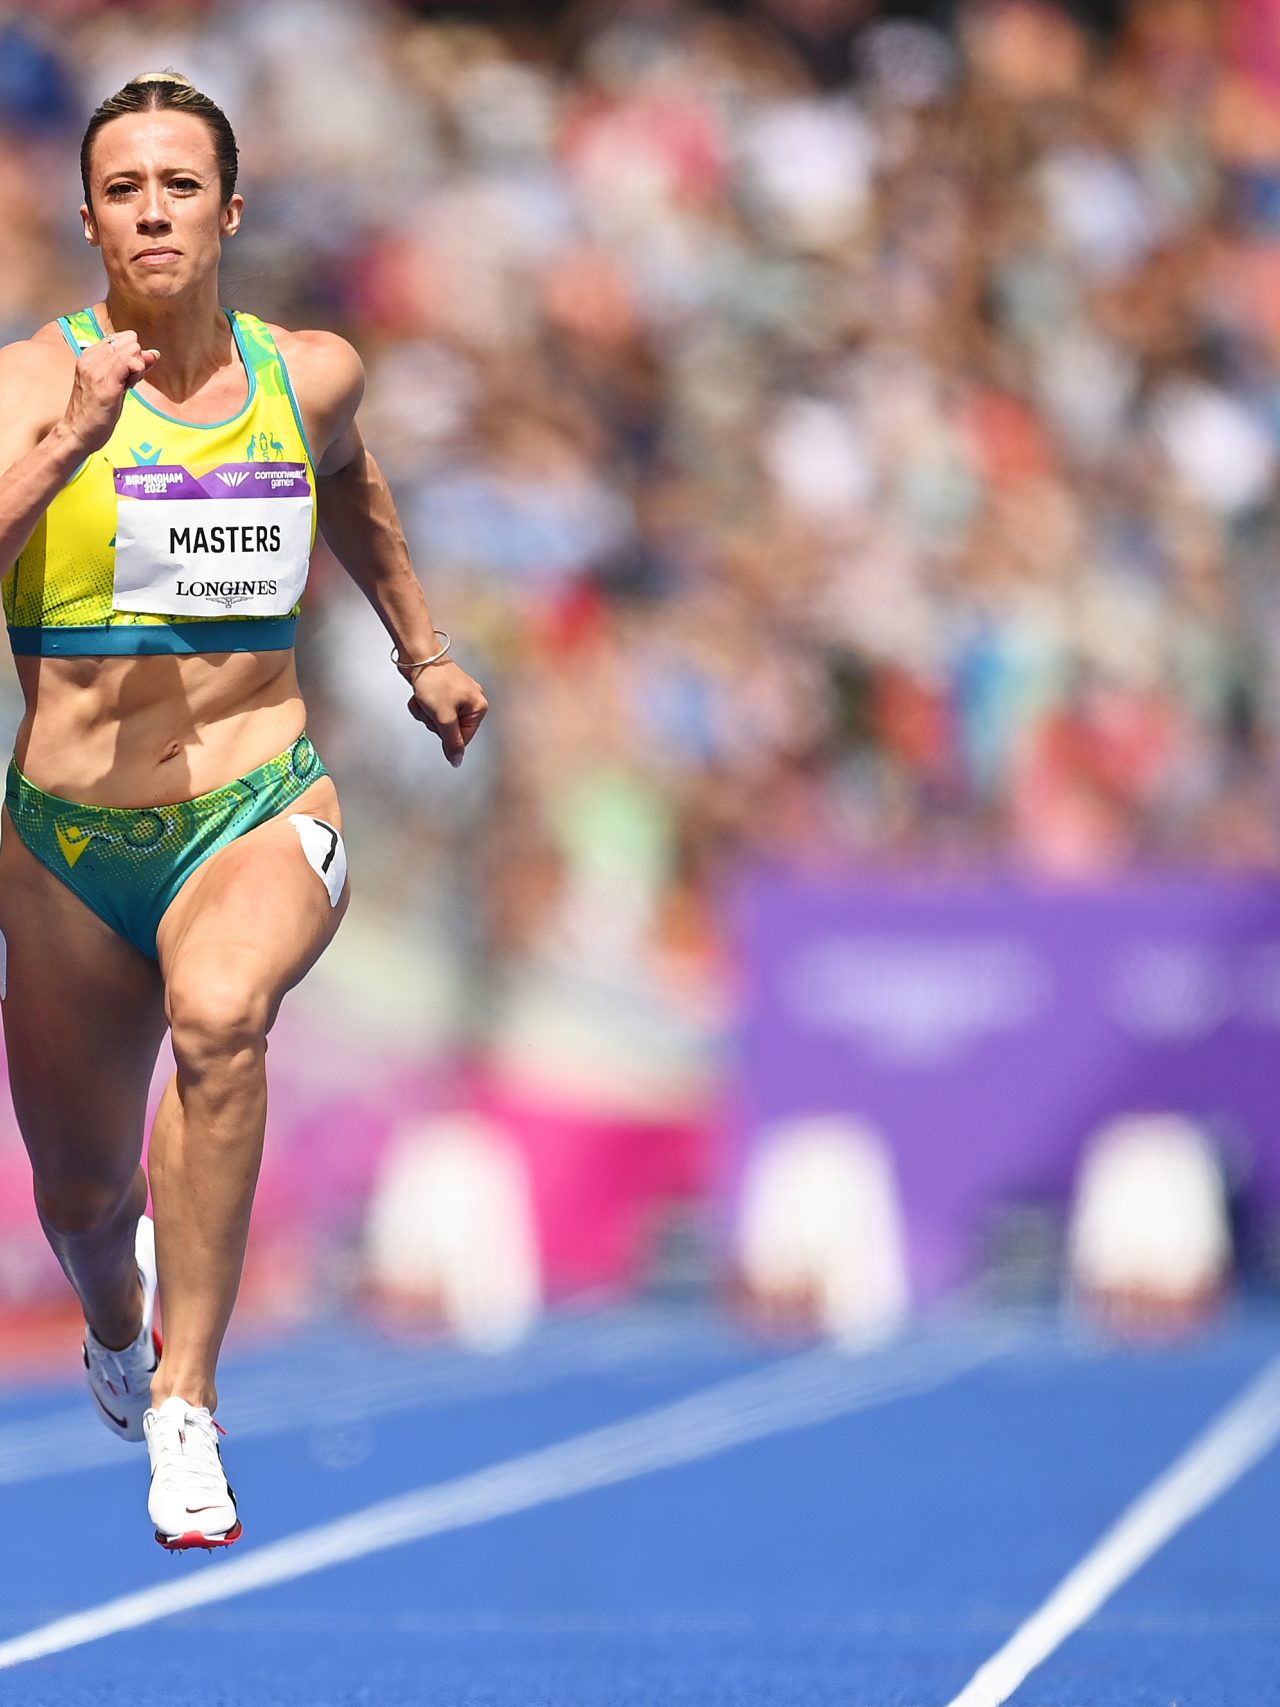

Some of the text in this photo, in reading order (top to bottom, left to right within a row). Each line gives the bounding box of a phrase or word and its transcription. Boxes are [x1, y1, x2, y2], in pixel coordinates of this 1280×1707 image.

[125, 472, 183, 485] BIRMINGHAM
[271, 479, 294, 489] games
[144, 483, 167, 494] 2022
[169, 525, 281, 554] MASTERS
[176, 580, 277, 597] LONGINES
